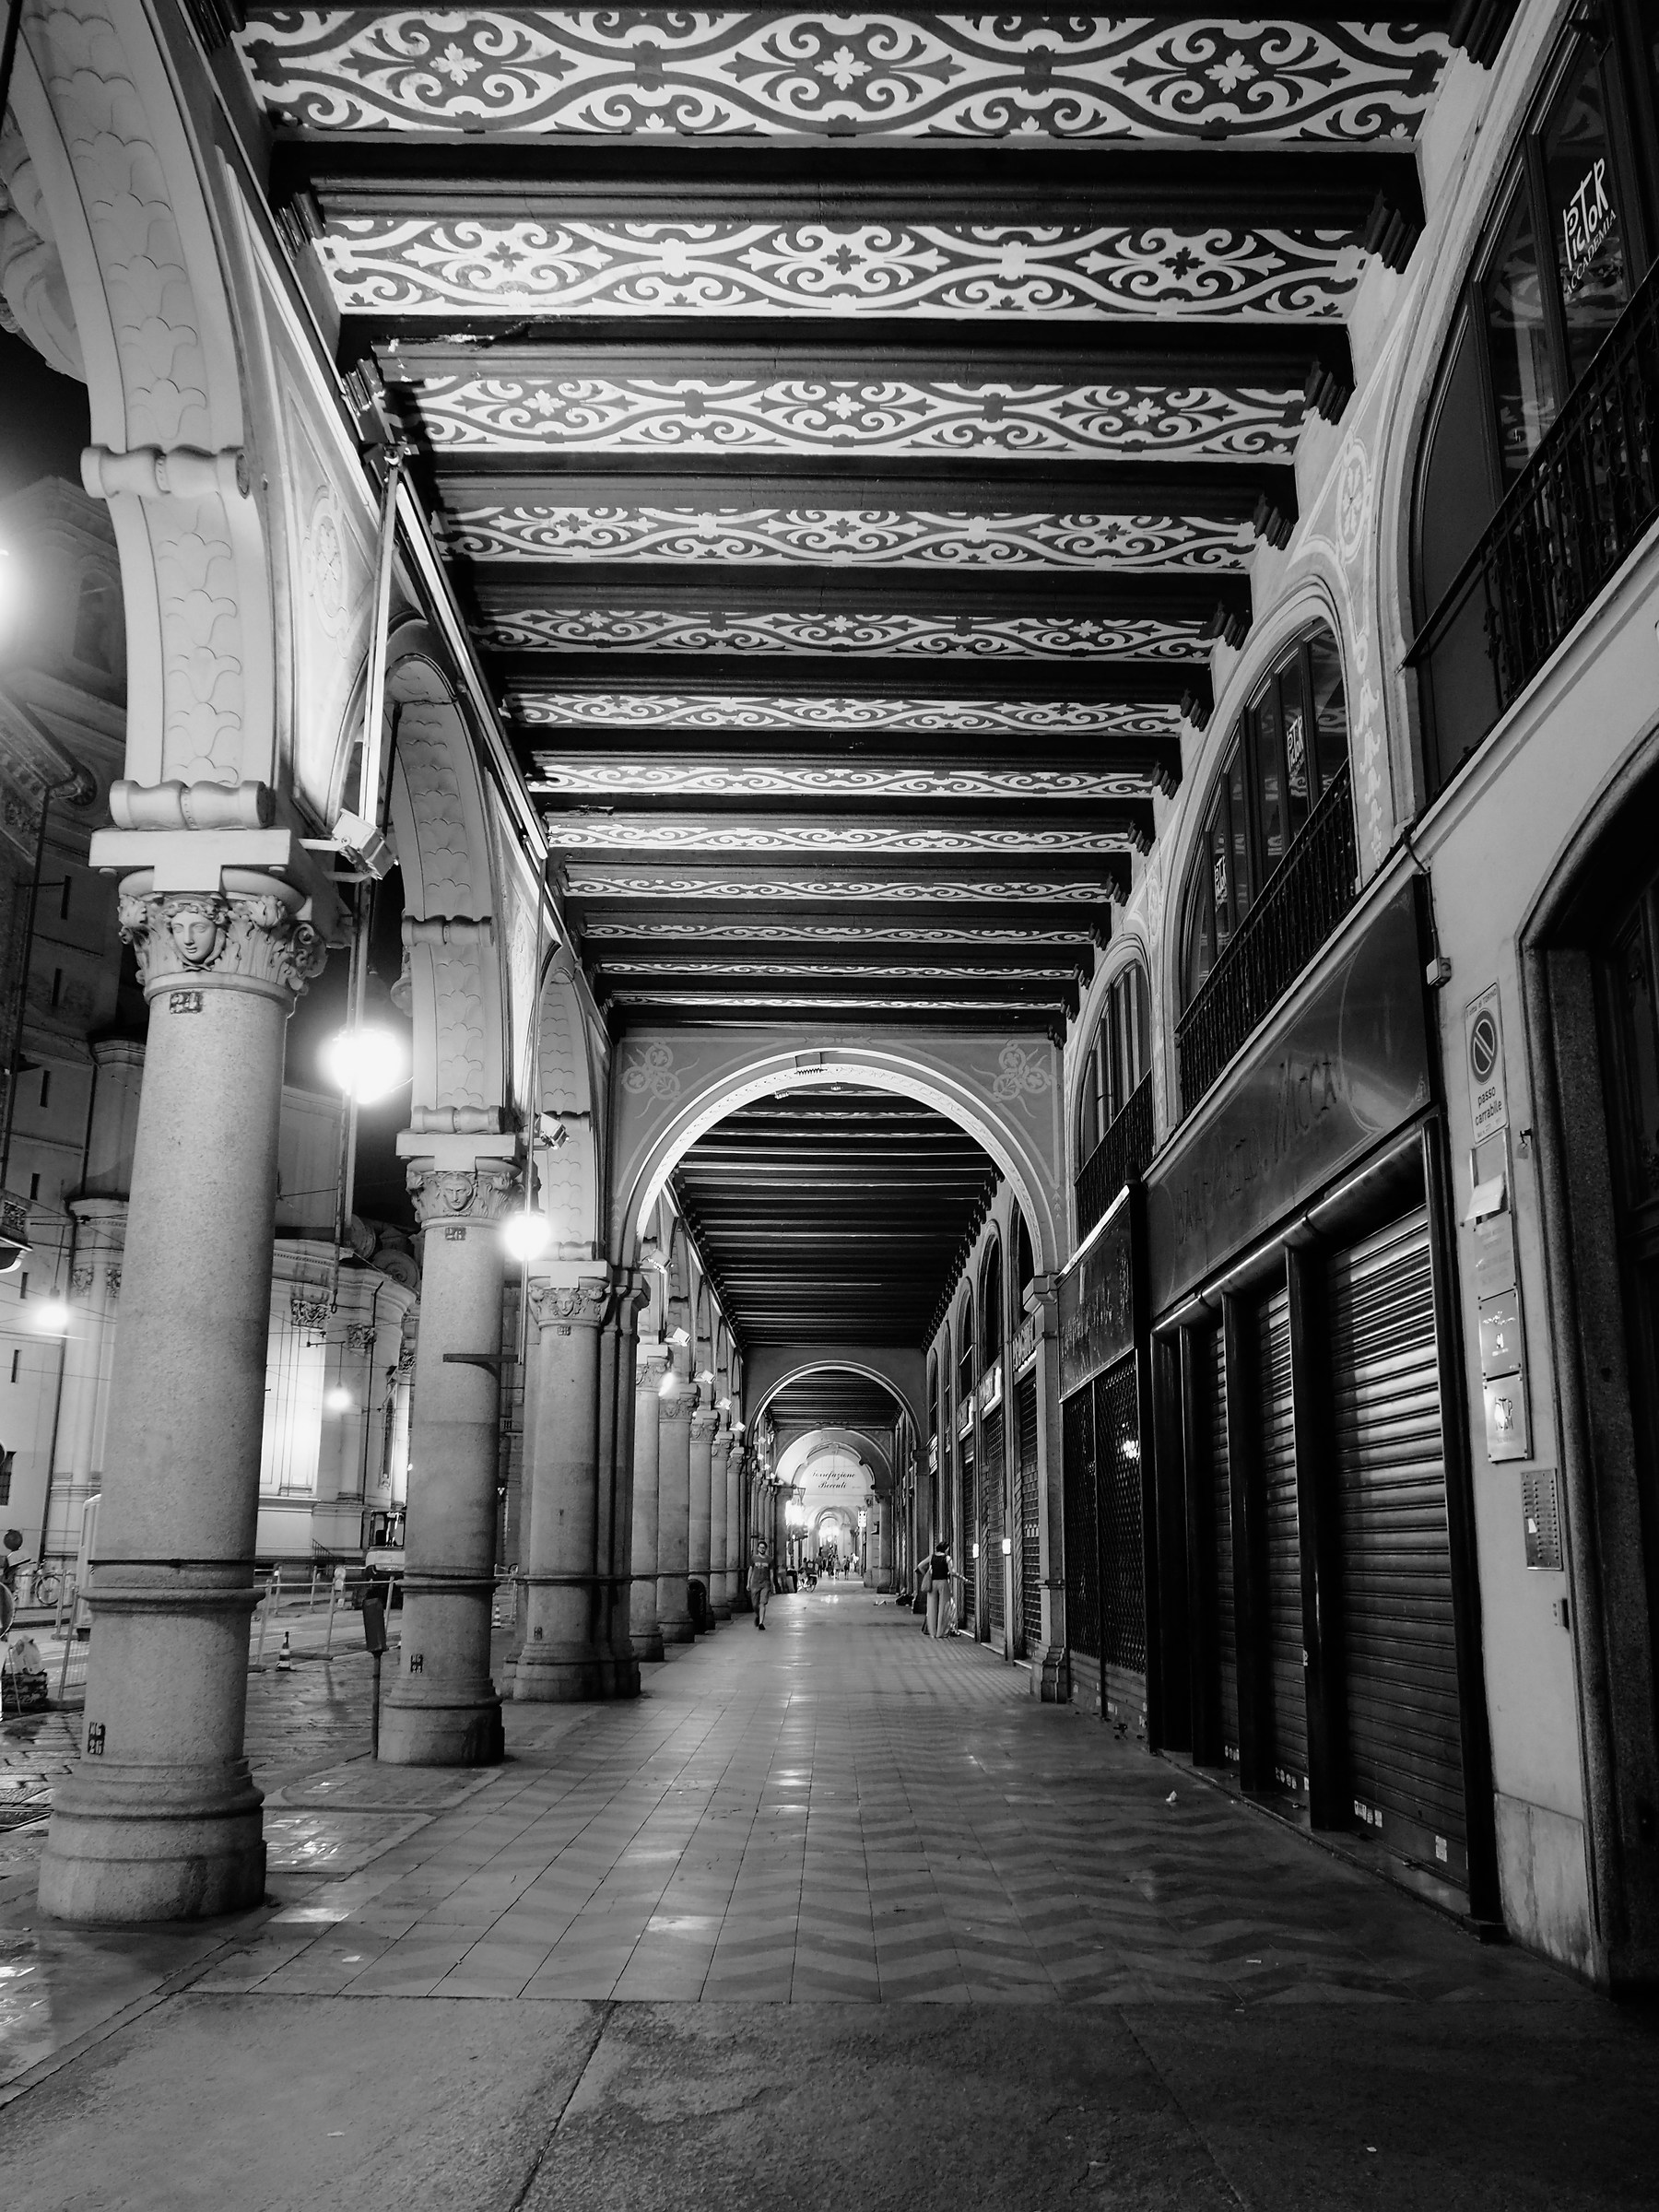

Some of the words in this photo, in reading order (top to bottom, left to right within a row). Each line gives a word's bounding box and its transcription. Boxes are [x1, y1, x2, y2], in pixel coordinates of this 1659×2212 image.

[1565, 209, 1617, 295] ACCADEMIA
[1477, 1087, 1496, 1110] passo
[1476, 1100, 1502, 1126] carrabile
